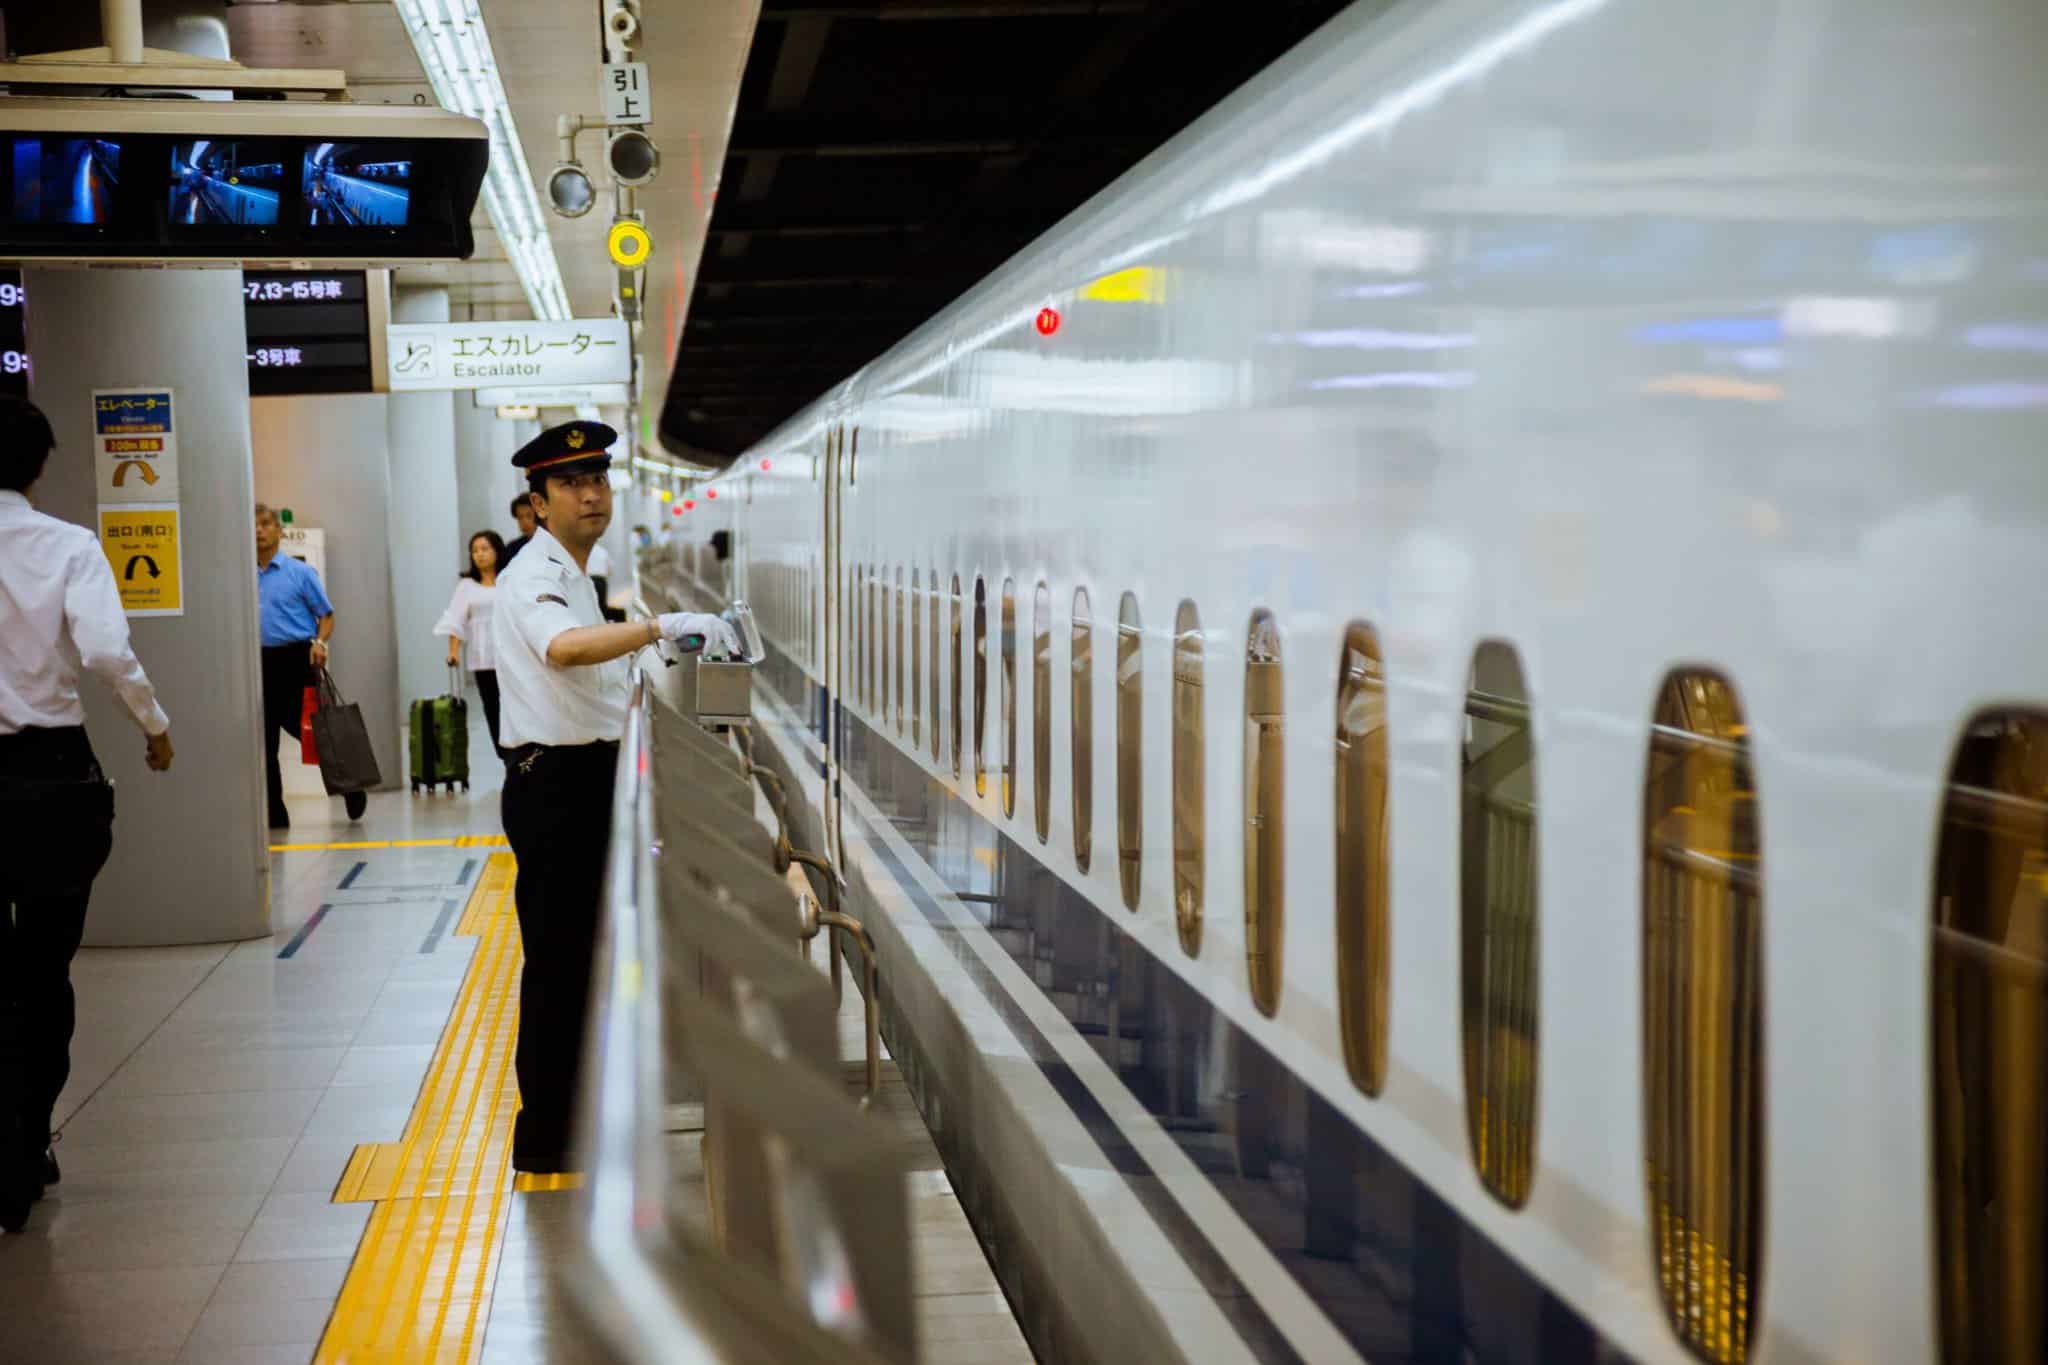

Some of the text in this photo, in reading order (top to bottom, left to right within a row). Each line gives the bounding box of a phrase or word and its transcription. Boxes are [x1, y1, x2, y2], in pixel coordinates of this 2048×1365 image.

[613, 68, 641, 119] 引上
[452, 332, 617, 357] エスカレーター
[454, 361, 542, 378] Escalator
